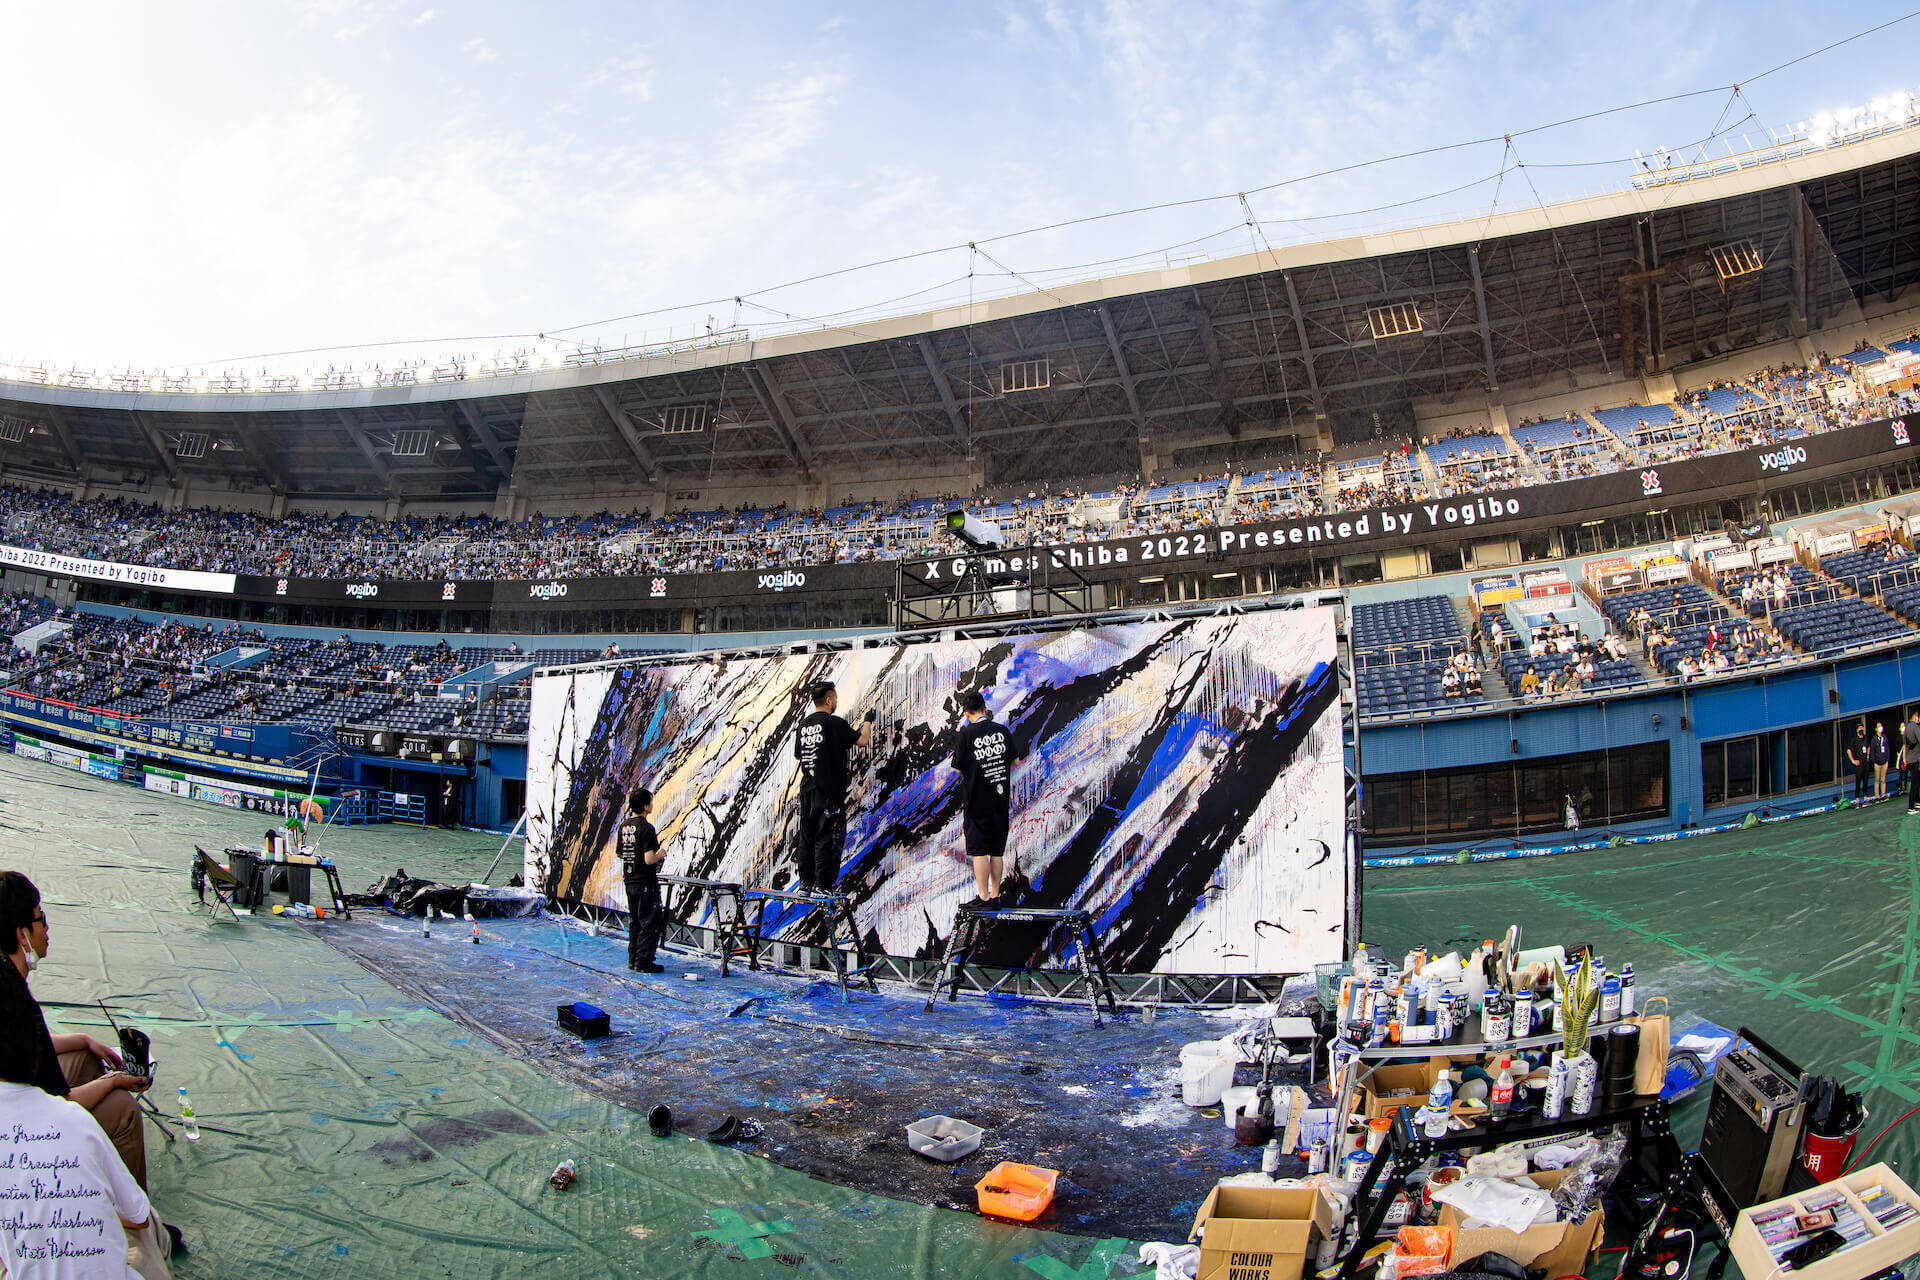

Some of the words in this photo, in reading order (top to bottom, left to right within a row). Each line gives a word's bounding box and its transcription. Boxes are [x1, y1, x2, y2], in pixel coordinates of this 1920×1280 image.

[1759, 445, 1807, 471] yogibo
[925, 562, 940, 579] X
[952, 554, 1038, 576] Gmes
[1052, 546, 1128, 568] Chiba
[1141, 534, 1206, 560] 2022
[1220, 514, 1370, 550] Presented
[1382, 512, 1414, 534] by
[1424, 497, 1520, 526] Yogibo
[22, 552, 46, 566] 2022
[50, 556, 105, 576] Presented
[109, 565, 121, 580] by
[127, 568, 166, 582] Yogibo
[346, 582, 378, 599] yogibo
[530, 582, 568, 600] yogibo
[758, 570, 806, 592] yogibo
[403, 742, 431, 752] SOLA
[974, 732, 1004, 748] GOLD
[13, 1123, 61, 1144] Francis
[20, 1152, 80, 1179] Crawford
[31, 1178, 101, 1201] Richardson
[0, 1210, 44, 1240] tephon
[48, 1208, 104, 1236] Marbury
[16, 1240, 46, 1259] Nate
[46, 1238, 105, 1260] Robinson
[1230, 1252, 1272, 1267] COLOUR
[1230, 1268, 1270, 1280] WORKS
